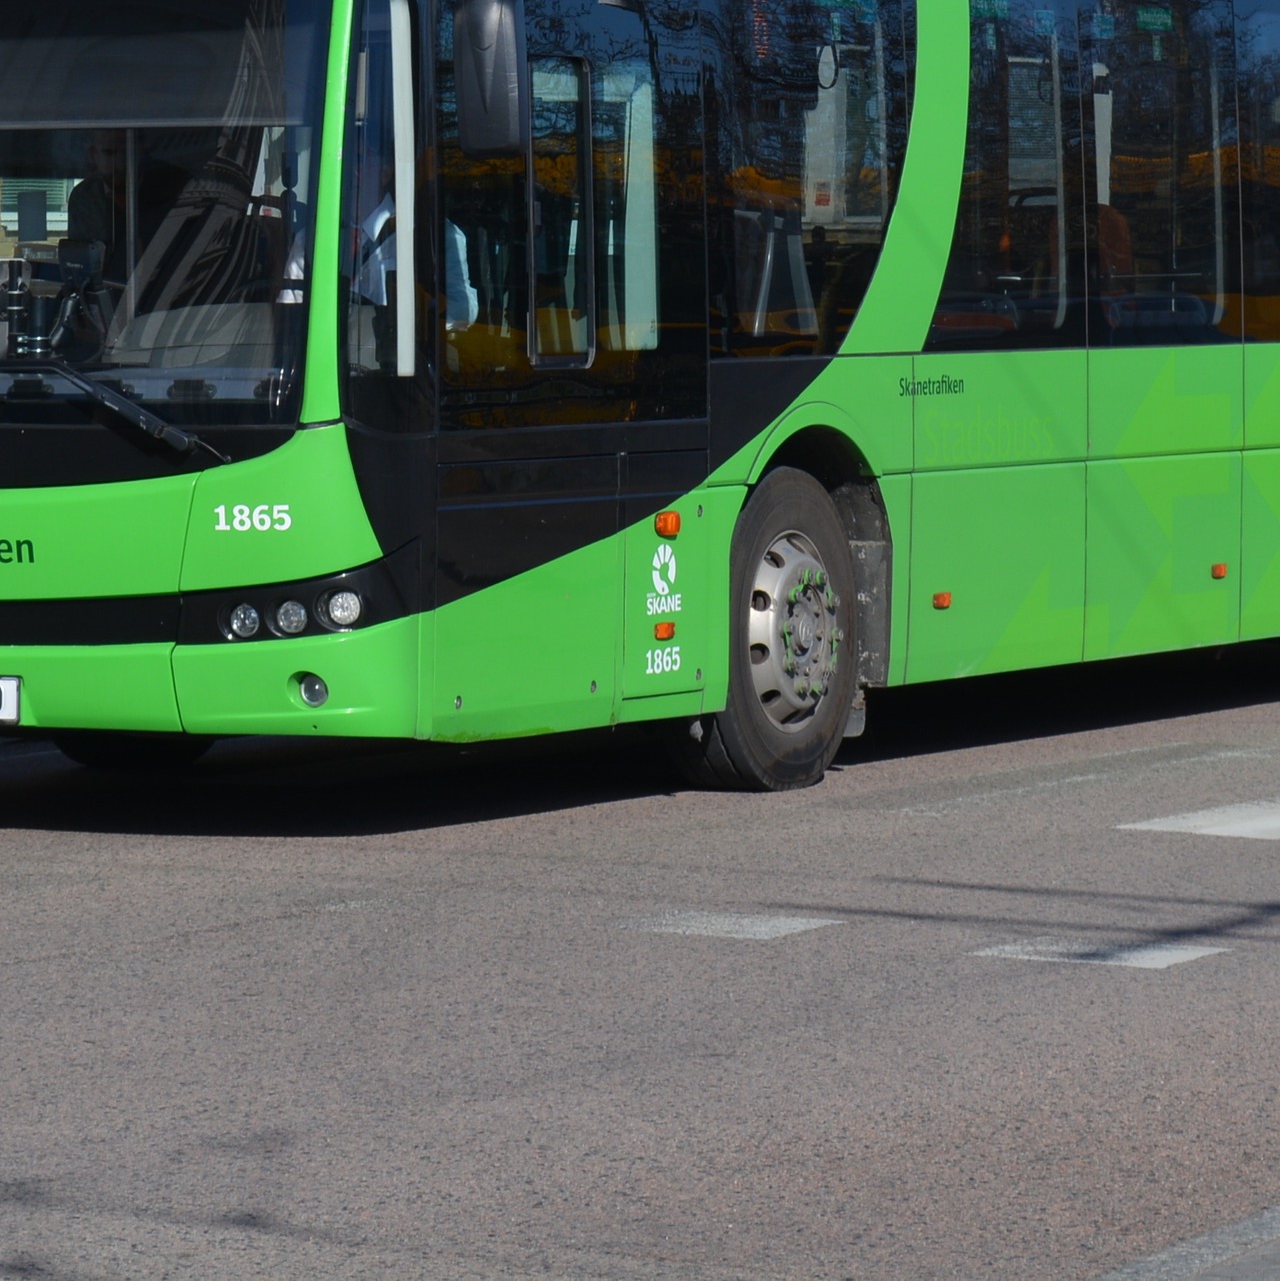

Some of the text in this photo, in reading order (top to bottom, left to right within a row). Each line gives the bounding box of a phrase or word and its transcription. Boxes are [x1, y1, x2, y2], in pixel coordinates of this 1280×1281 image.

[899, 374, 965, 397] Skånetrafiken
[214, 503, 293, 532] 1865
[645, 645, 681, 675] 1865
